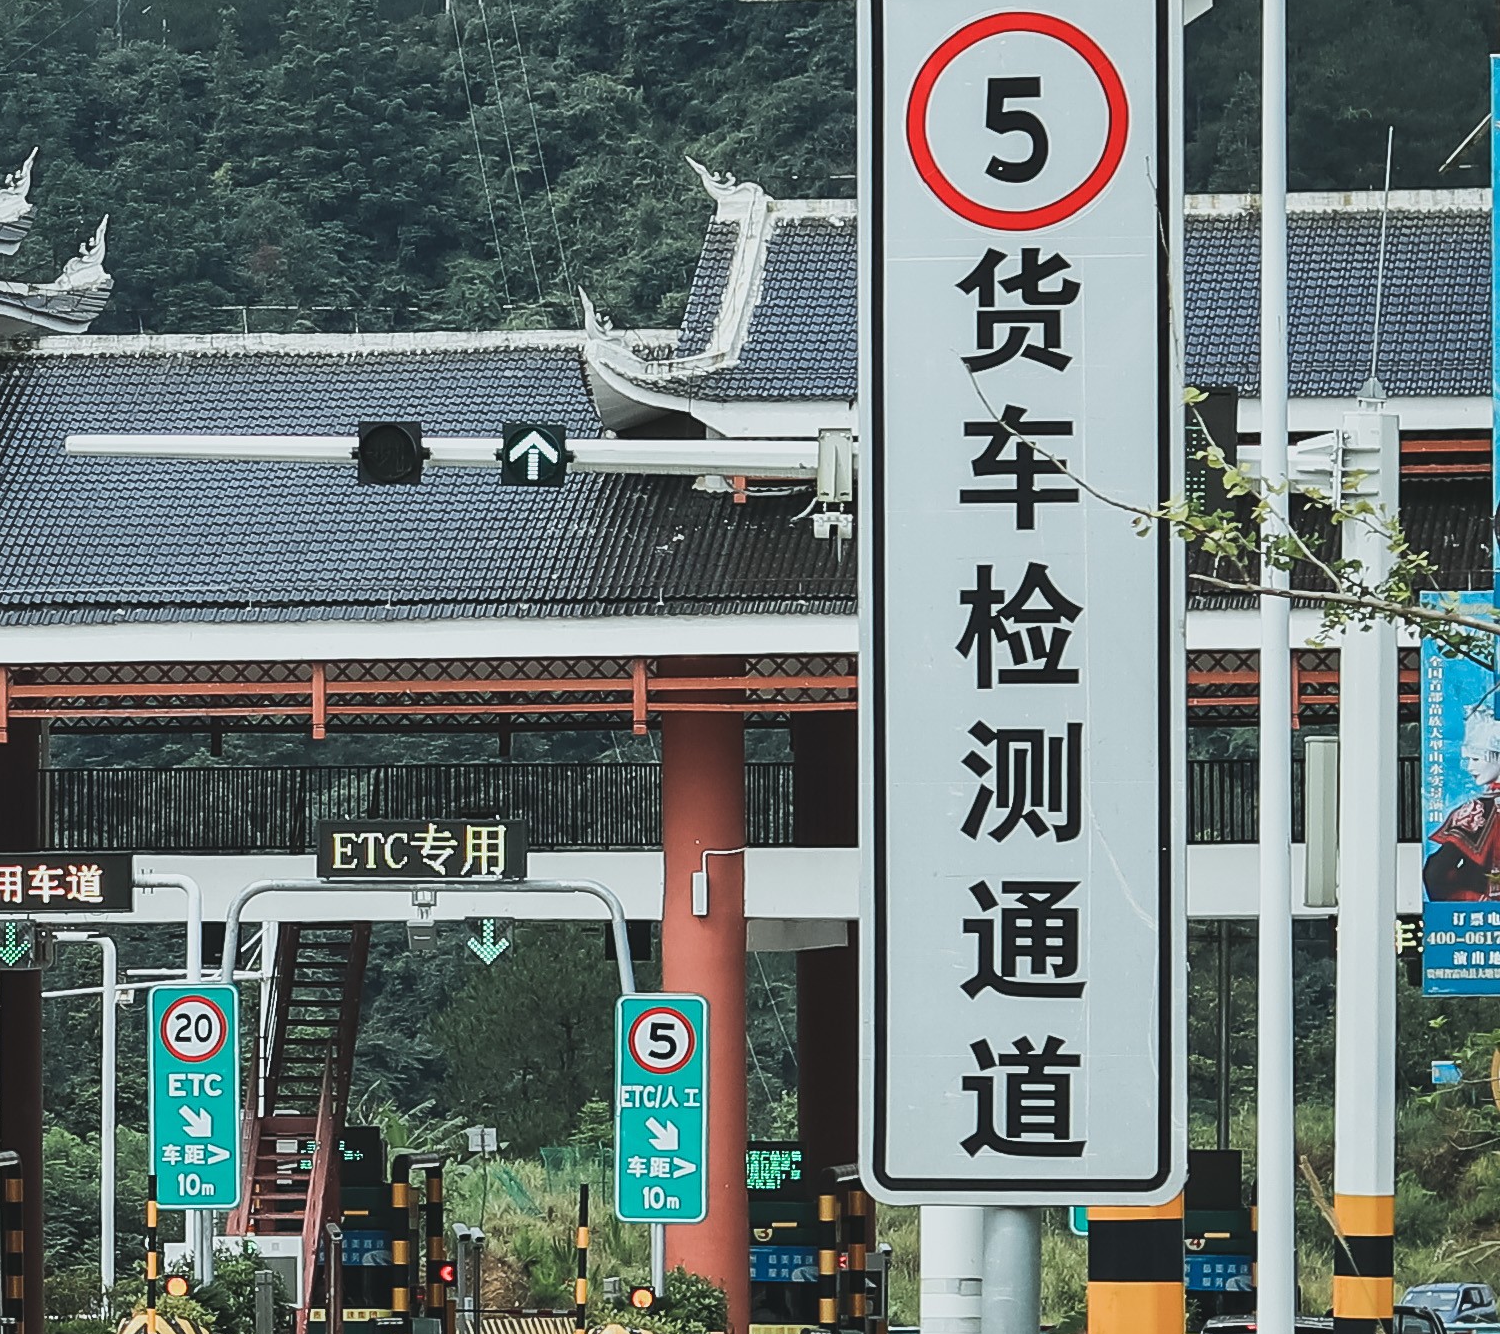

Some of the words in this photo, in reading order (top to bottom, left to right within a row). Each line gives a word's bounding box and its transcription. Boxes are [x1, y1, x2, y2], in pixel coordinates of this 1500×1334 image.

[985, 77, 1049, 183] 5
[955, 247, 1088, 1158] 货车检测通道
[332, 823, 506, 875] ETC专用
[174, 1013, 213, 1043] 20
[648, 1022, 677, 1060] 5
[168, 1073, 223, 1097] ETC
[620, 1084, 700, 1108] ETC/人工
[177, 1173, 215, 1196] 10m
[642, 1186, 680, 1210] 10m
